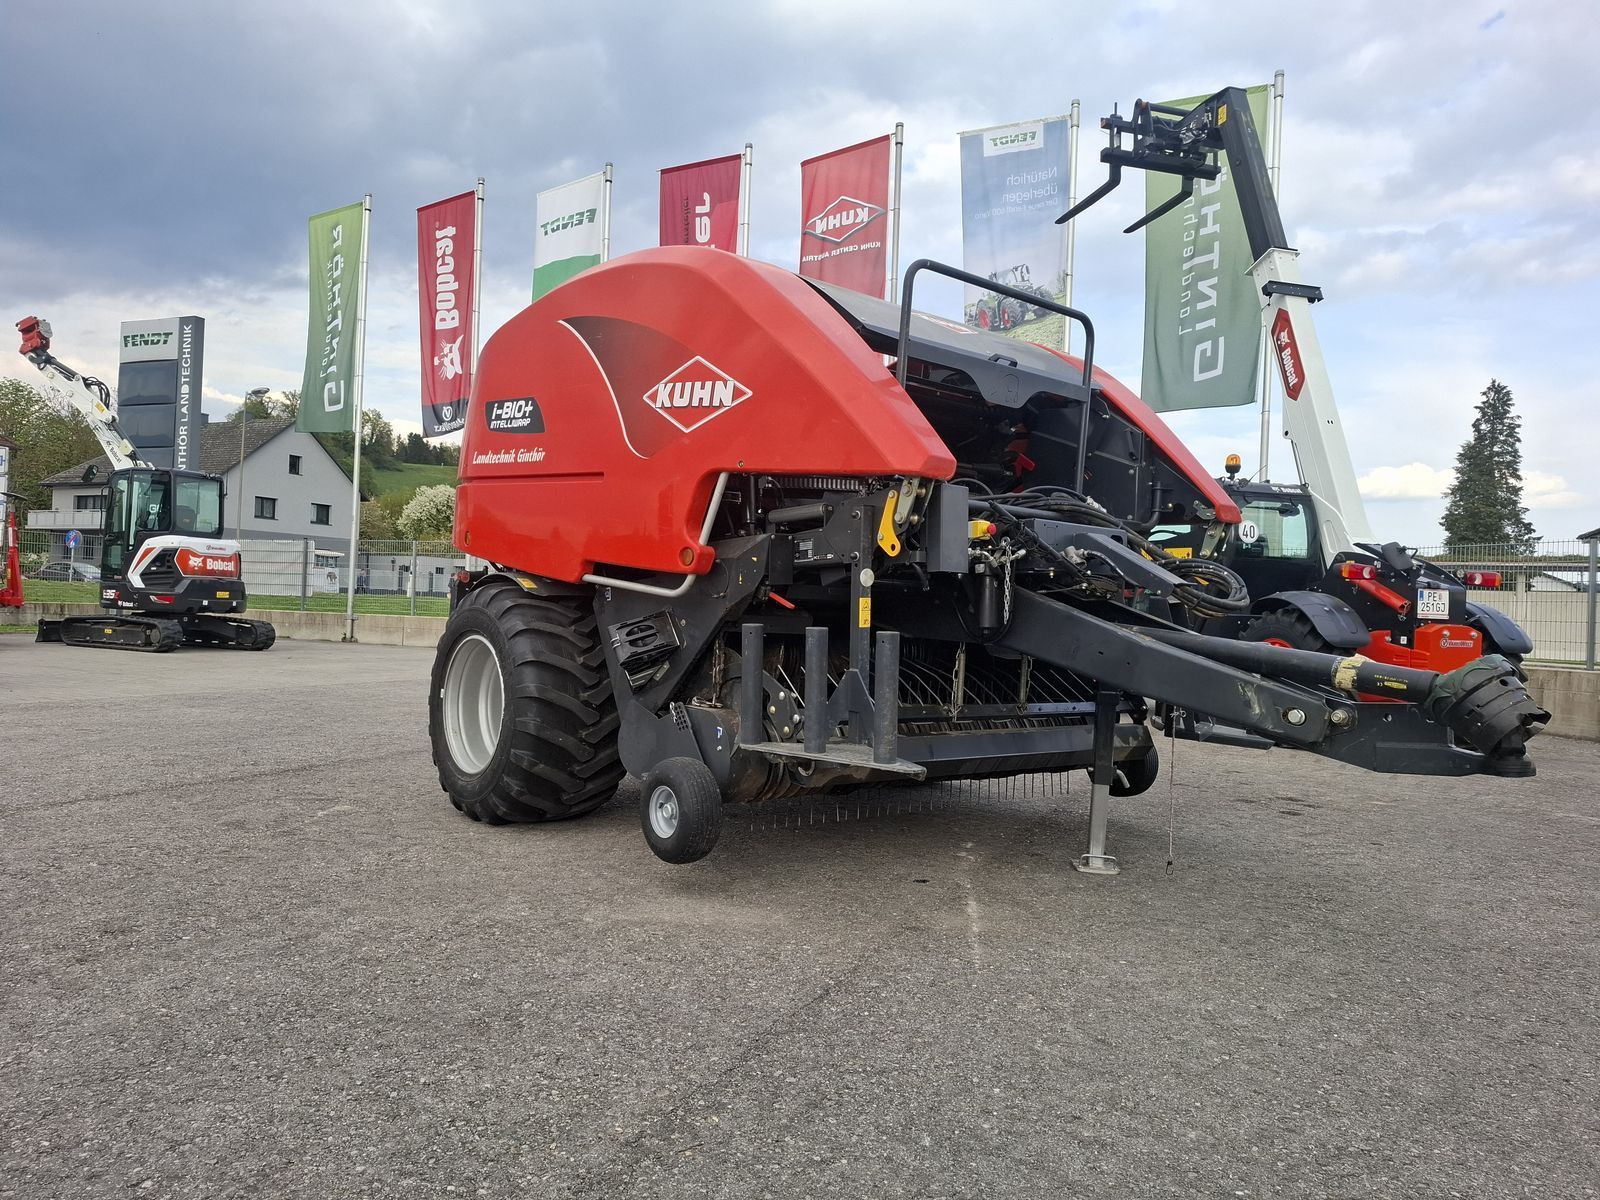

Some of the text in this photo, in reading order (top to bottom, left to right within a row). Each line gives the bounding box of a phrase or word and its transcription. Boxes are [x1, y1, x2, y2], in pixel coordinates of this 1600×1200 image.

[123, 332, 173, 348] FENDT
[1282, 347, 1298, 388] Bobcat
[177, 324, 192, 471] NTHÖR LANDTECHNIK
[655, 380, 735, 408] KUHN
[492, 400, 533, 419] i-BIO+
[490, 418, 531, 429] INTELLIWRAP
[473, 447, 545, 464] Landtechnik Ginthör
[1242, 522, 1255, 538] 40
[207, 558, 234, 571] Bobcat
[1427, 592, 1437, 601] PE
[1421, 602, 1446, 613] 251GJ
